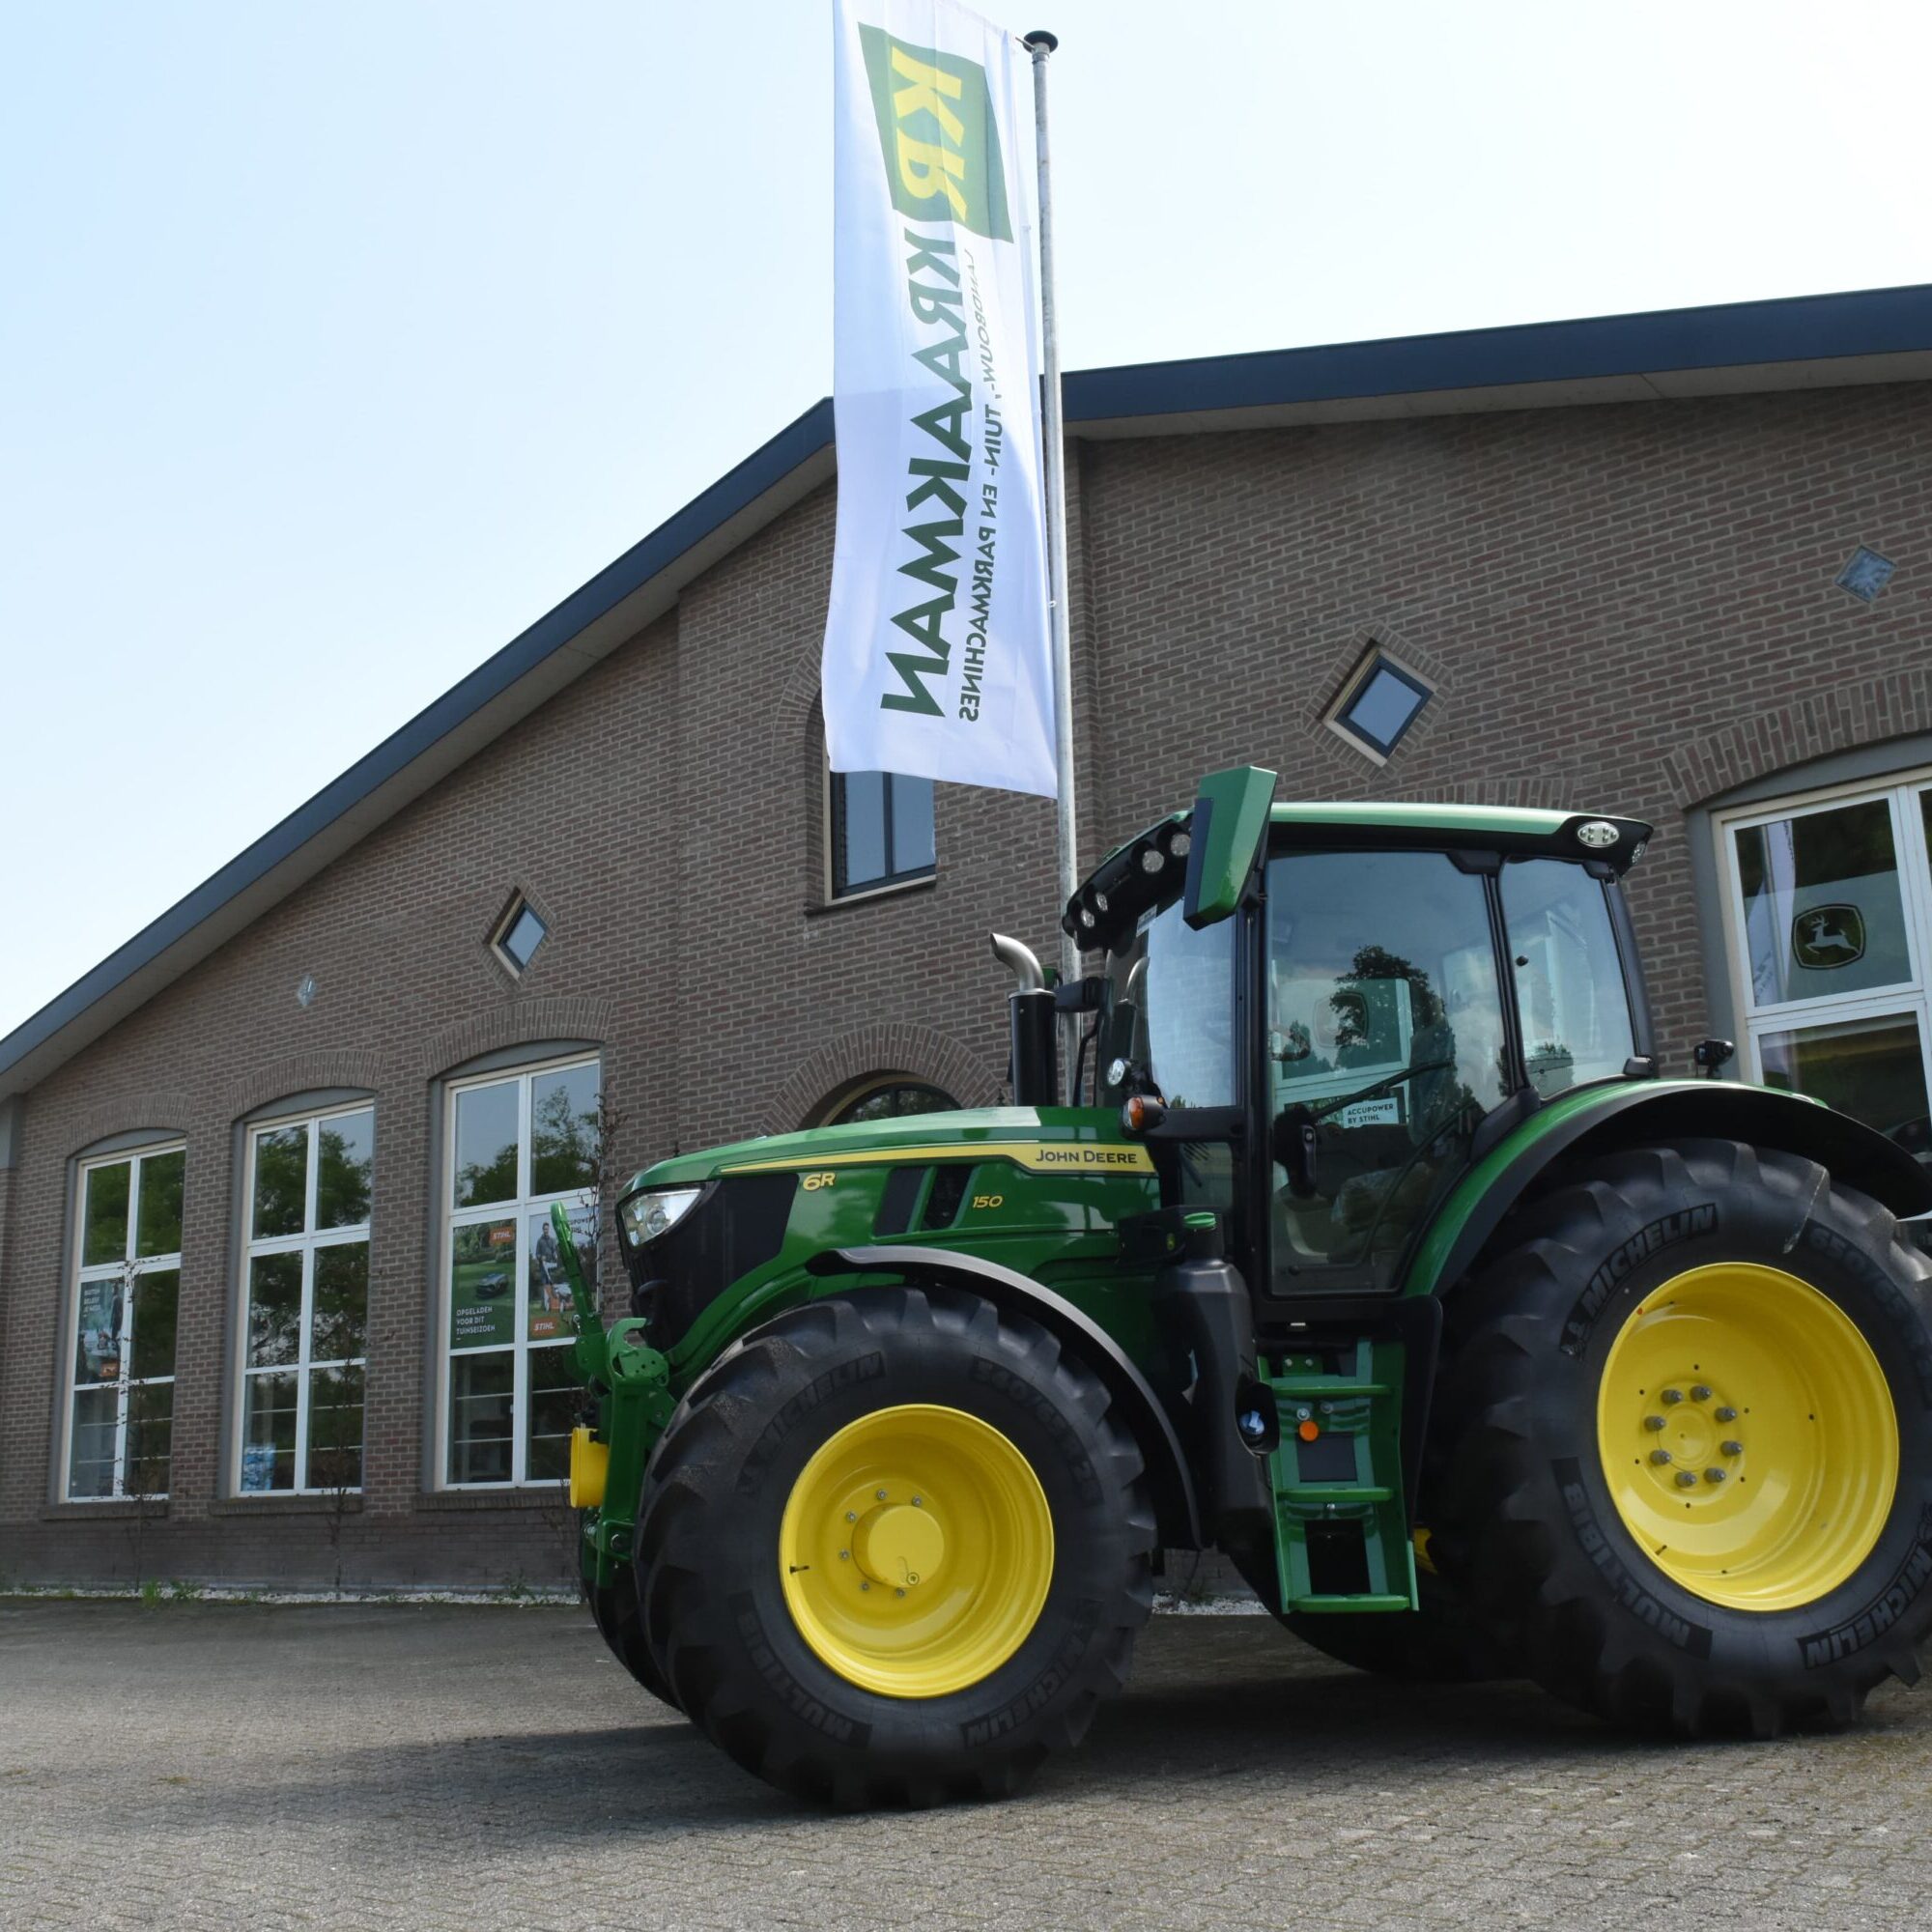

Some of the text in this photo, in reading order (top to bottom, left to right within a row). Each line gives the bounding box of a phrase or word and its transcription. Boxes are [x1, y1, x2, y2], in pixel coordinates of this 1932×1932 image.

[1348, 1103, 1394, 1116] ACCUPOWER
[1359, 1114, 1380, 1122] STIHL
[1036, 1149, 1138, 1164] JOHN DEERE
[803, 1172, 837, 1191] 6R
[973, 1195, 1004, 1208] 150
[493, 1231, 511, 1239] STIHL
[1580, 1205, 1716, 1319] MICHELIN
[456, 1316, 485, 1325] VOOR DIT
[534, 1321, 555, 1331] STIHL
[755, 1353, 885, 1464] MICHELIN
[1563, 1483, 1691, 1648] MULTIBIB
[1804, 1546, 1932, 1670] MICHELIN
[736, 1610, 853, 1742] MULTIBIB
[965, 1634, 1084, 1747] MICHELIN
